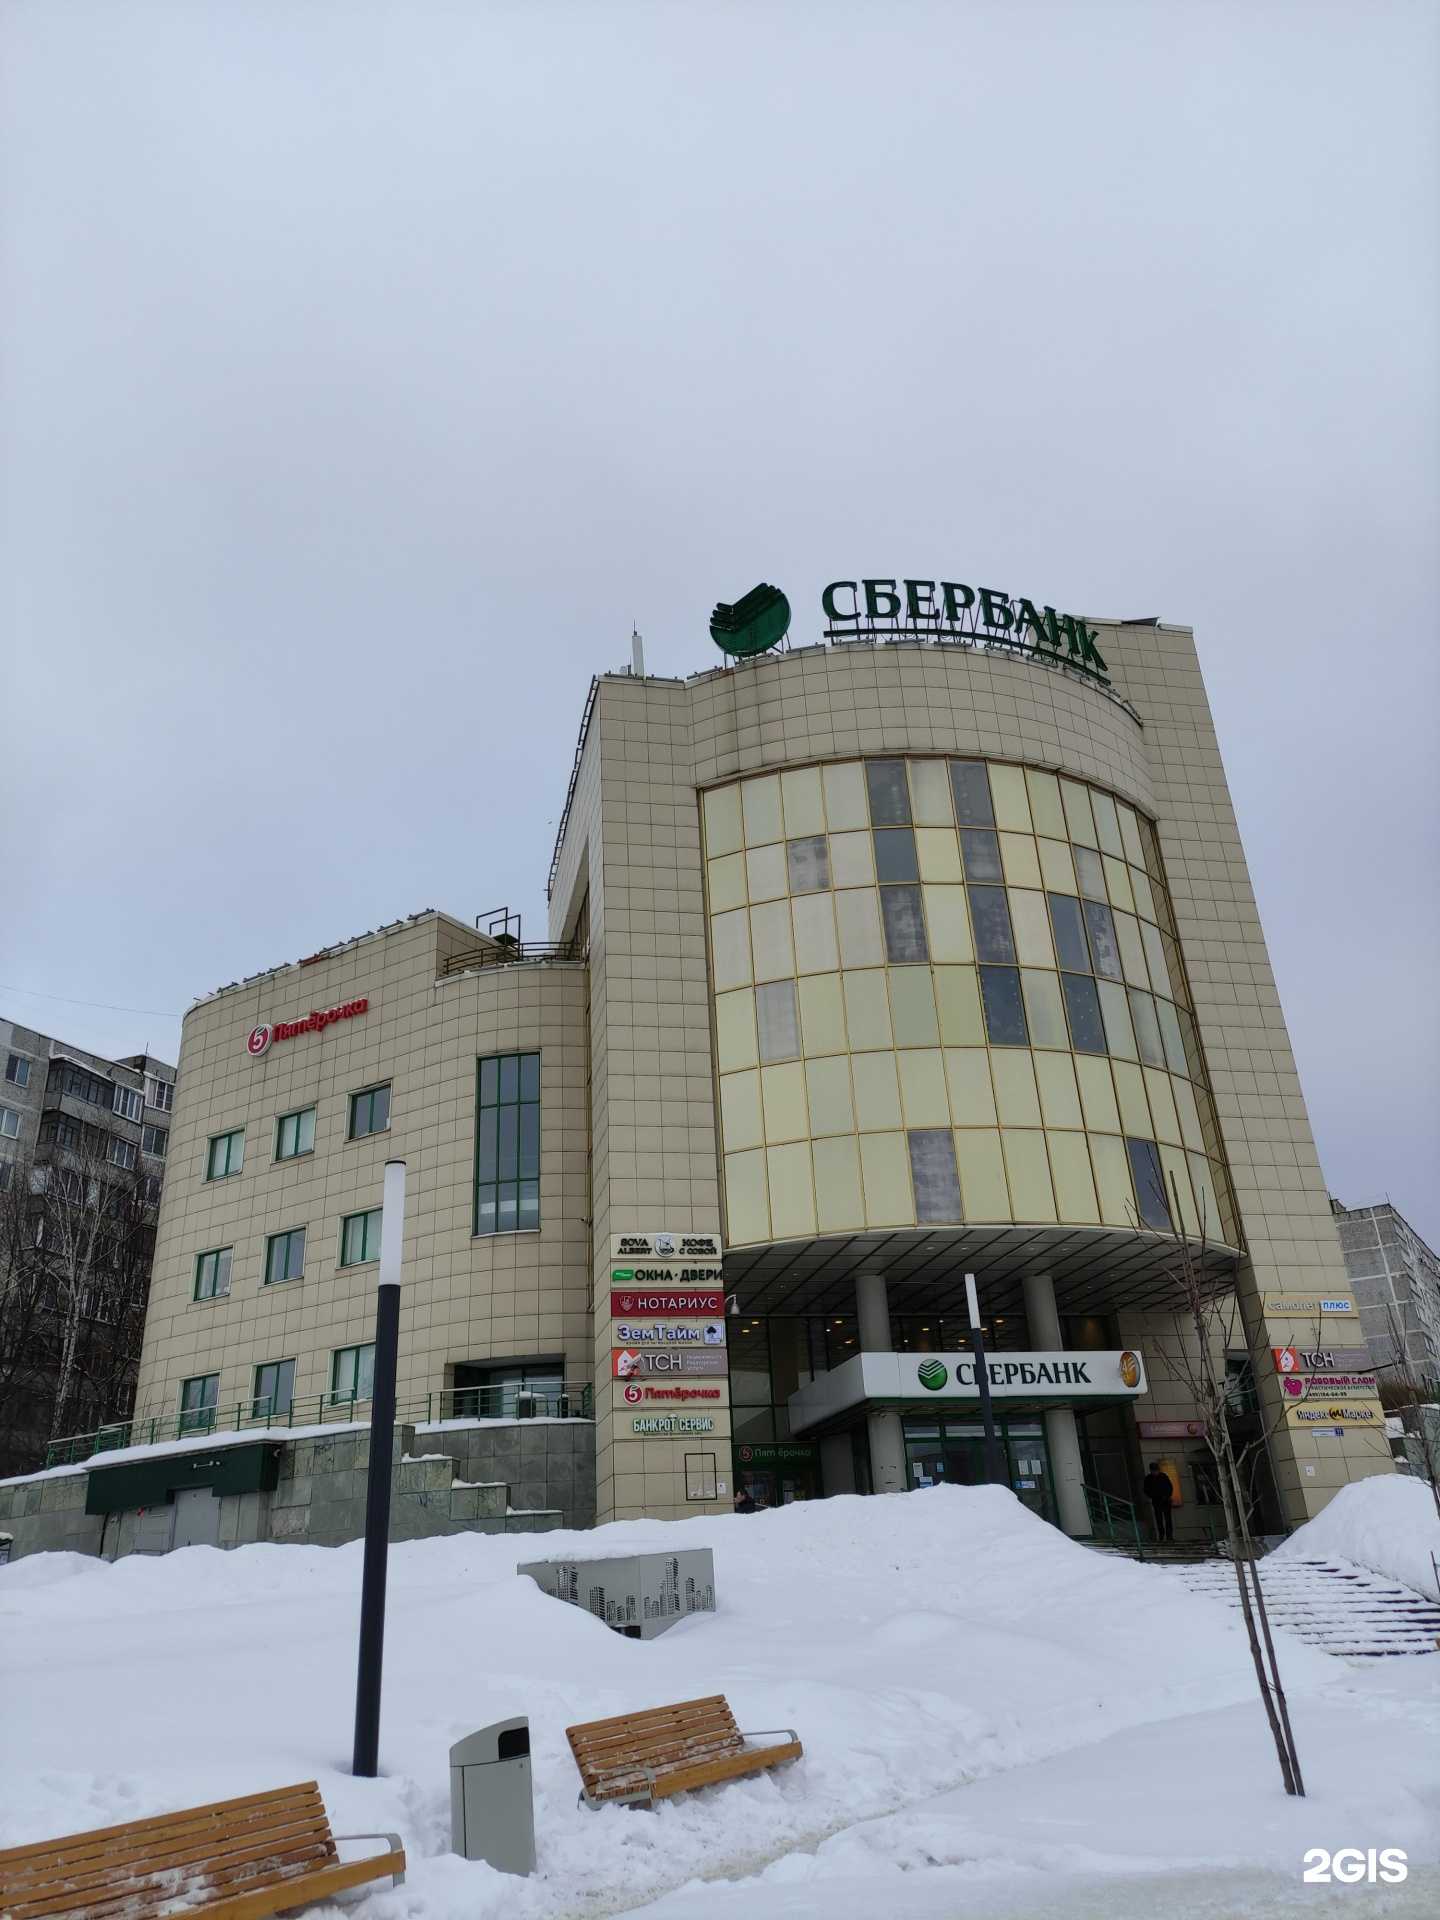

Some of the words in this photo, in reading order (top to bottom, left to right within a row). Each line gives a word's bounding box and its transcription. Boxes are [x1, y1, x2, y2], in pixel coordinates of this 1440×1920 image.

[822, 579, 1109, 672] СБЕРБАНК
[682, 1238, 713, 1247] КОФЕ
[635, 1269, 673, 1281] ОКНА
[680, 1269, 723, 1282] ДВЕРИ
[638, 1297, 718, 1309] НОТАРИУС
[618, 1324, 700, 1340] ЗемТайм
[645, 1354, 682, 1370] ТСН
[1301, 1352, 1335, 1367] ТСН
[1351, 1377, 1376, 1385] СЛОН
[633, 1418, 676, 1432] БАНКРОТ
[680, 1417, 714, 1431] СЕРВИС
